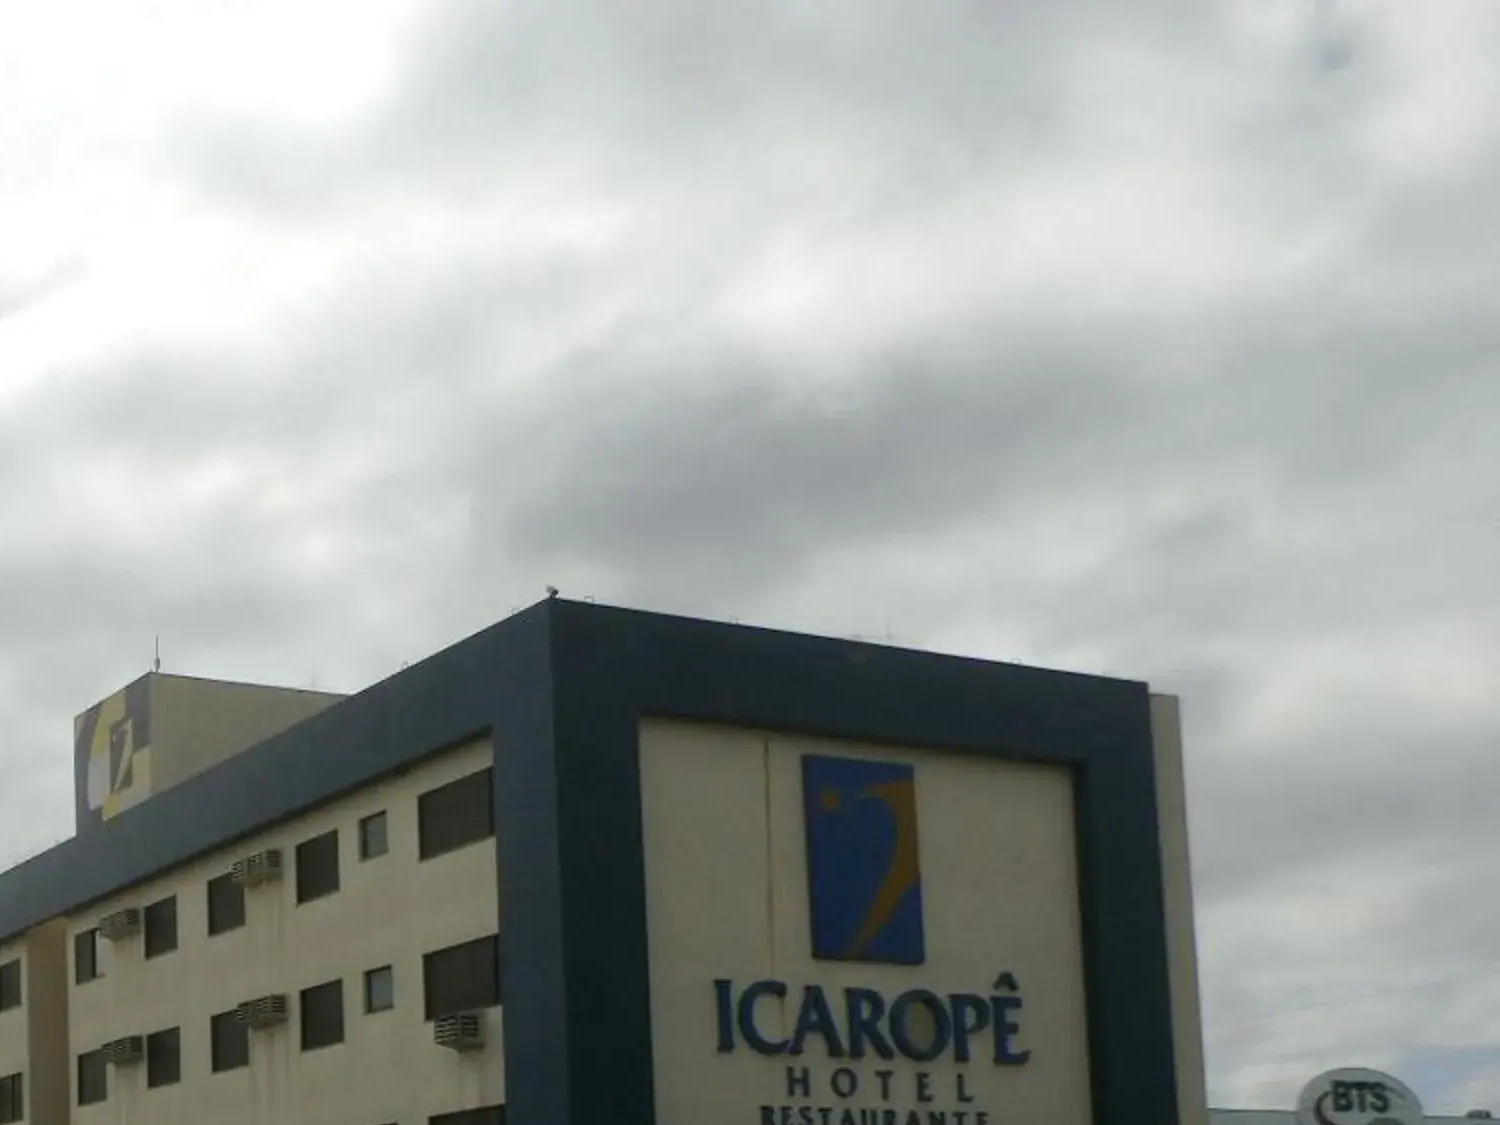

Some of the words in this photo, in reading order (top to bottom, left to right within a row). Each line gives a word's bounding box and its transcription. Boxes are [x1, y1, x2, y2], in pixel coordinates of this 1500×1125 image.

[713, 971, 1031, 1065] ICAROPÊ
[787, 1066, 974, 1103] HOTEL
[1331, 1079, 1391, 1113] BTS
